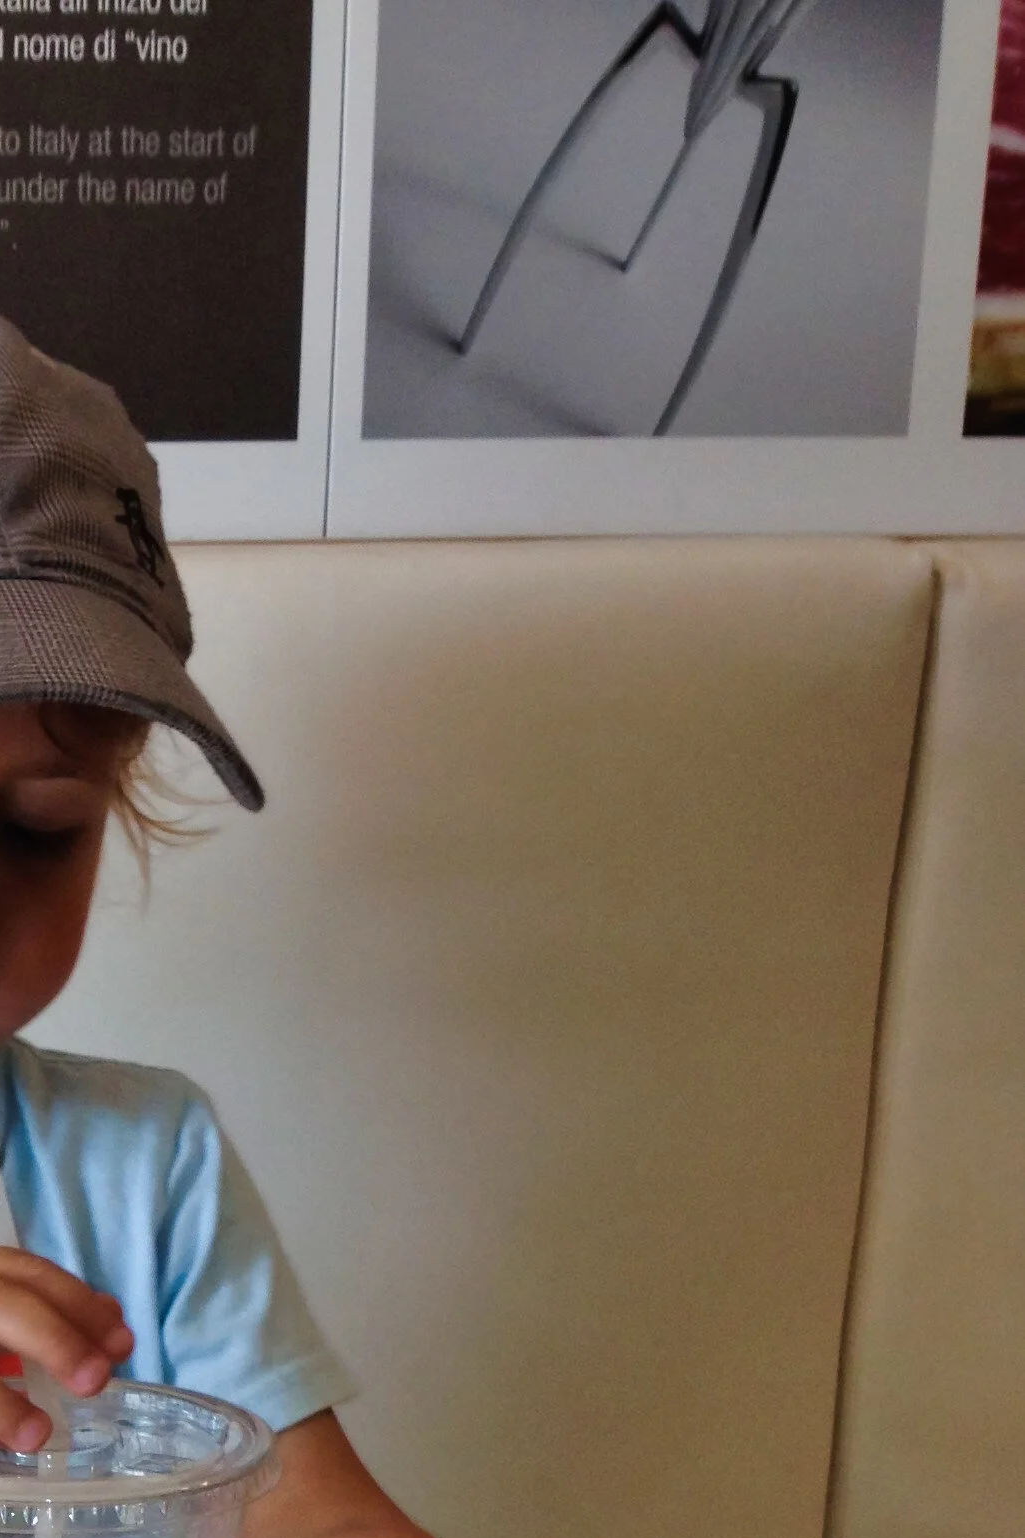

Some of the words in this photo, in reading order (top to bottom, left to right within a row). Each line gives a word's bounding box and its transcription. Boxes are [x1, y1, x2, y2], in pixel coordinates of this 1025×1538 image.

[12, 33, 85, 62] nome
[93, 28, 117, 62] di
[28, 124, 81, 162] Italy
[88, 126, 113, 156] at
[120, 126, 161, 156] the
[168, 127, 226, 157] start
[232, 126, 257, 156] of
[77, 173, 118, 204] the
[125, 179, 196, 204] name
[202, 172, 229, 204] of
